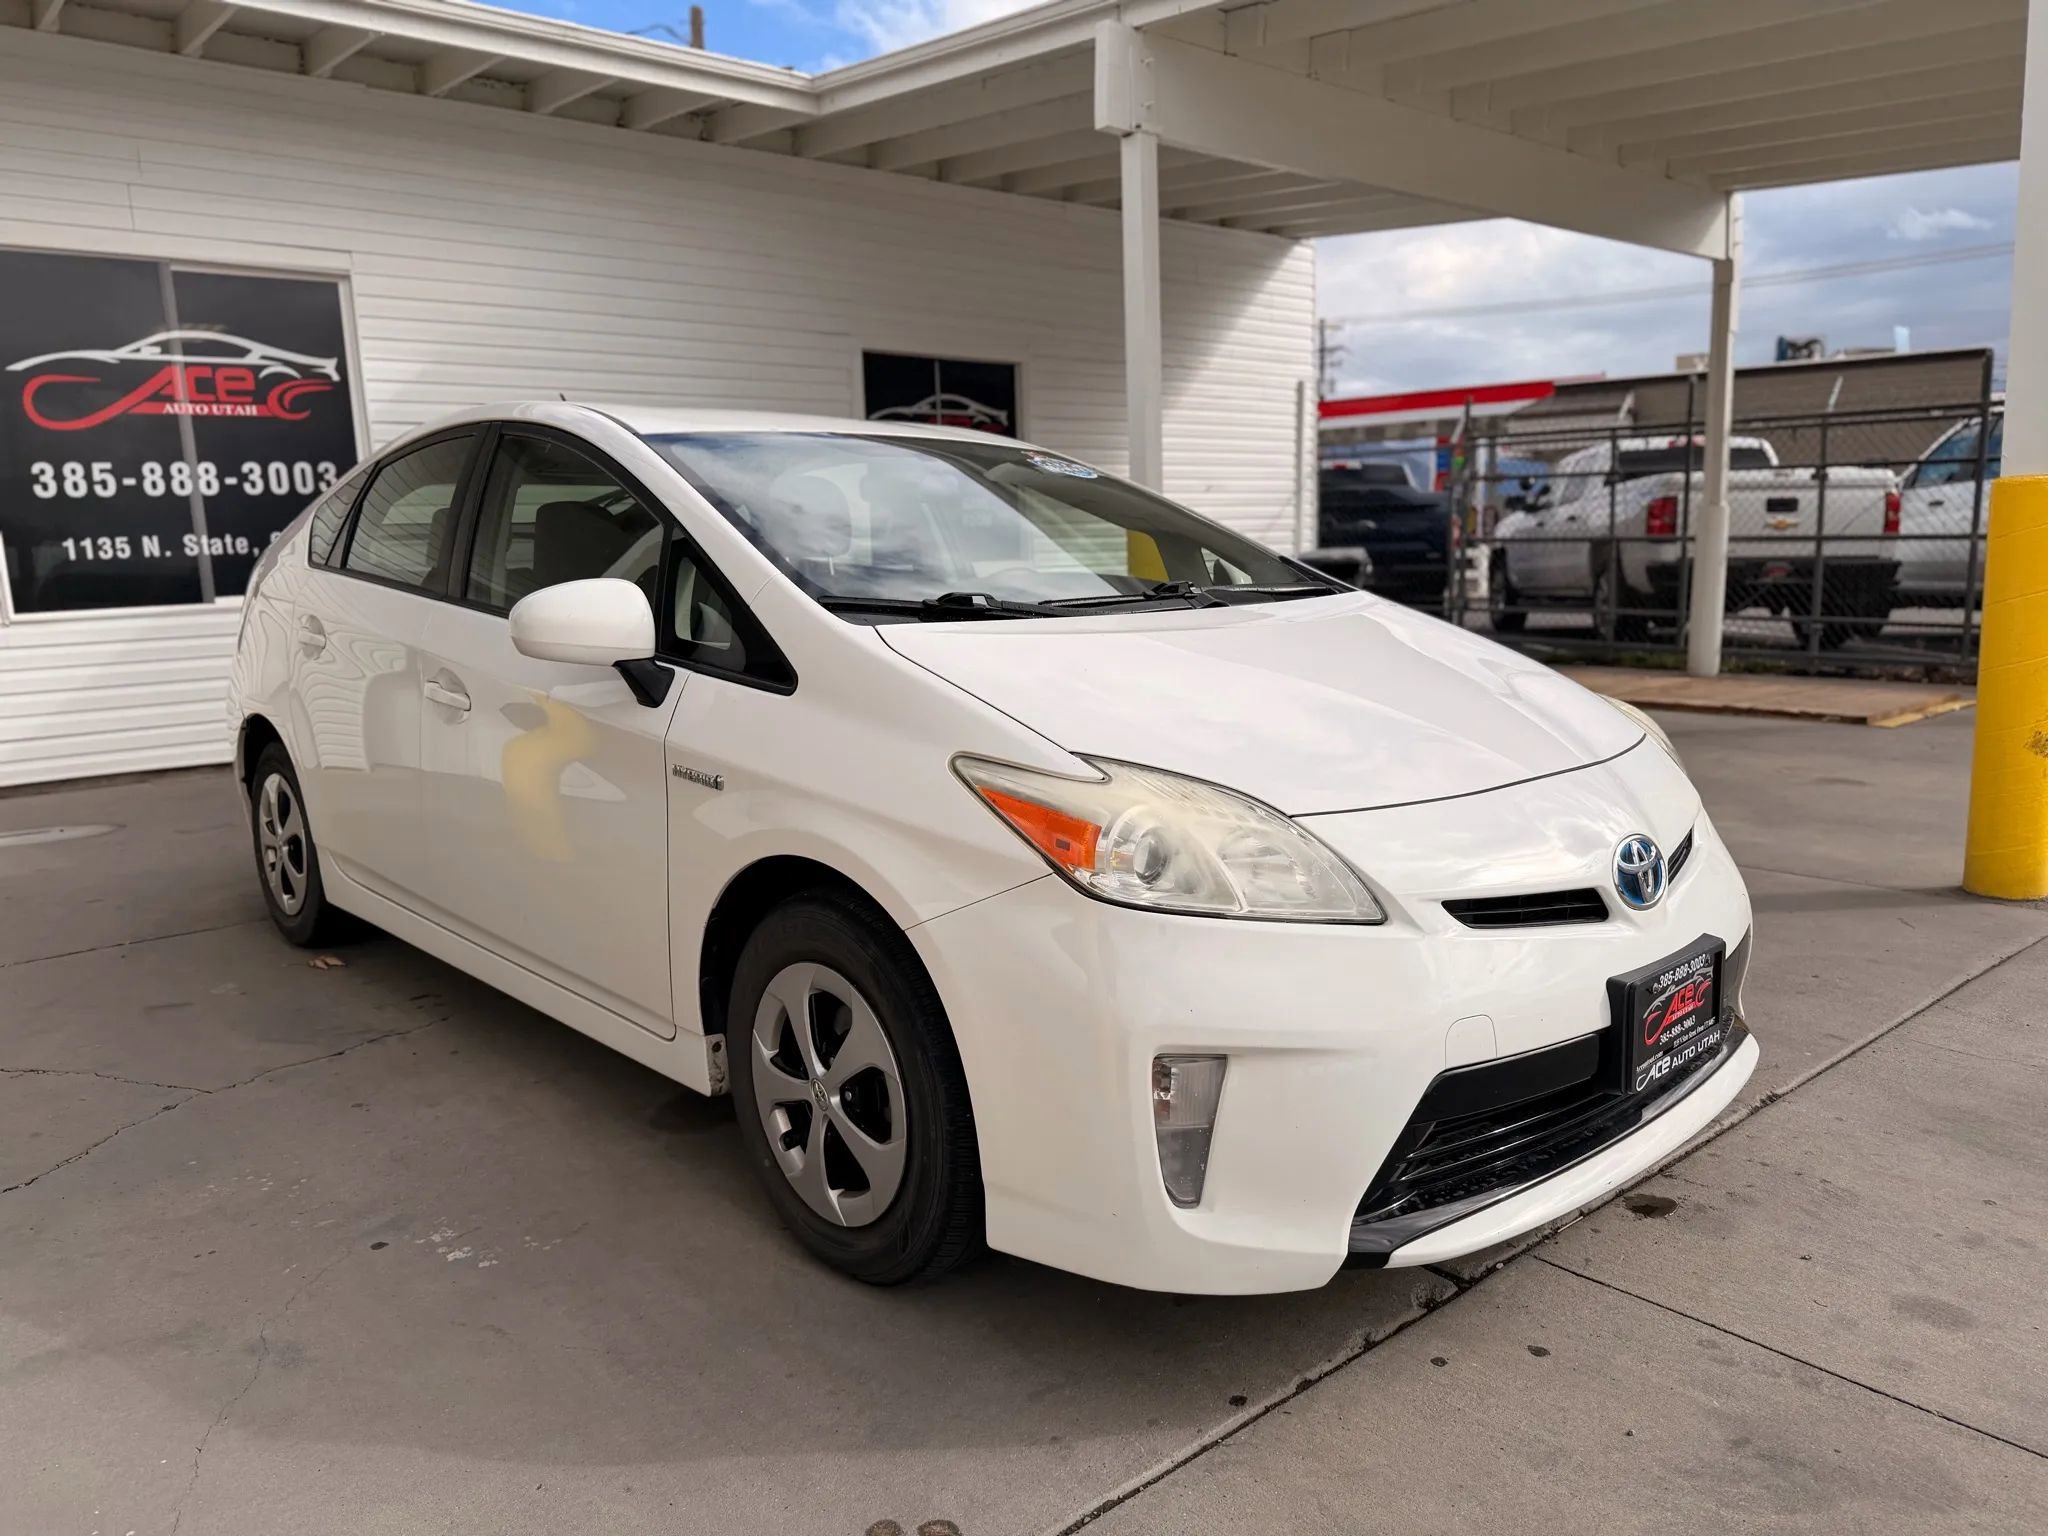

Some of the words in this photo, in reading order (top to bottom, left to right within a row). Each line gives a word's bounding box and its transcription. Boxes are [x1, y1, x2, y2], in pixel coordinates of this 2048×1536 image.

[163, 402, 208, 416] AUTO
[211, 403, 258, 416] UTAH
[31, 460, 340, 499] 385-888-3003
[62, 535, 131, 561] 1135
[142, 534, 172, 558] N.
[183, 532, 260, 558] State,
[1672, 1046, 1696, 1069] AUTO
[1697, 1029, 1720, 1052] UTAH
